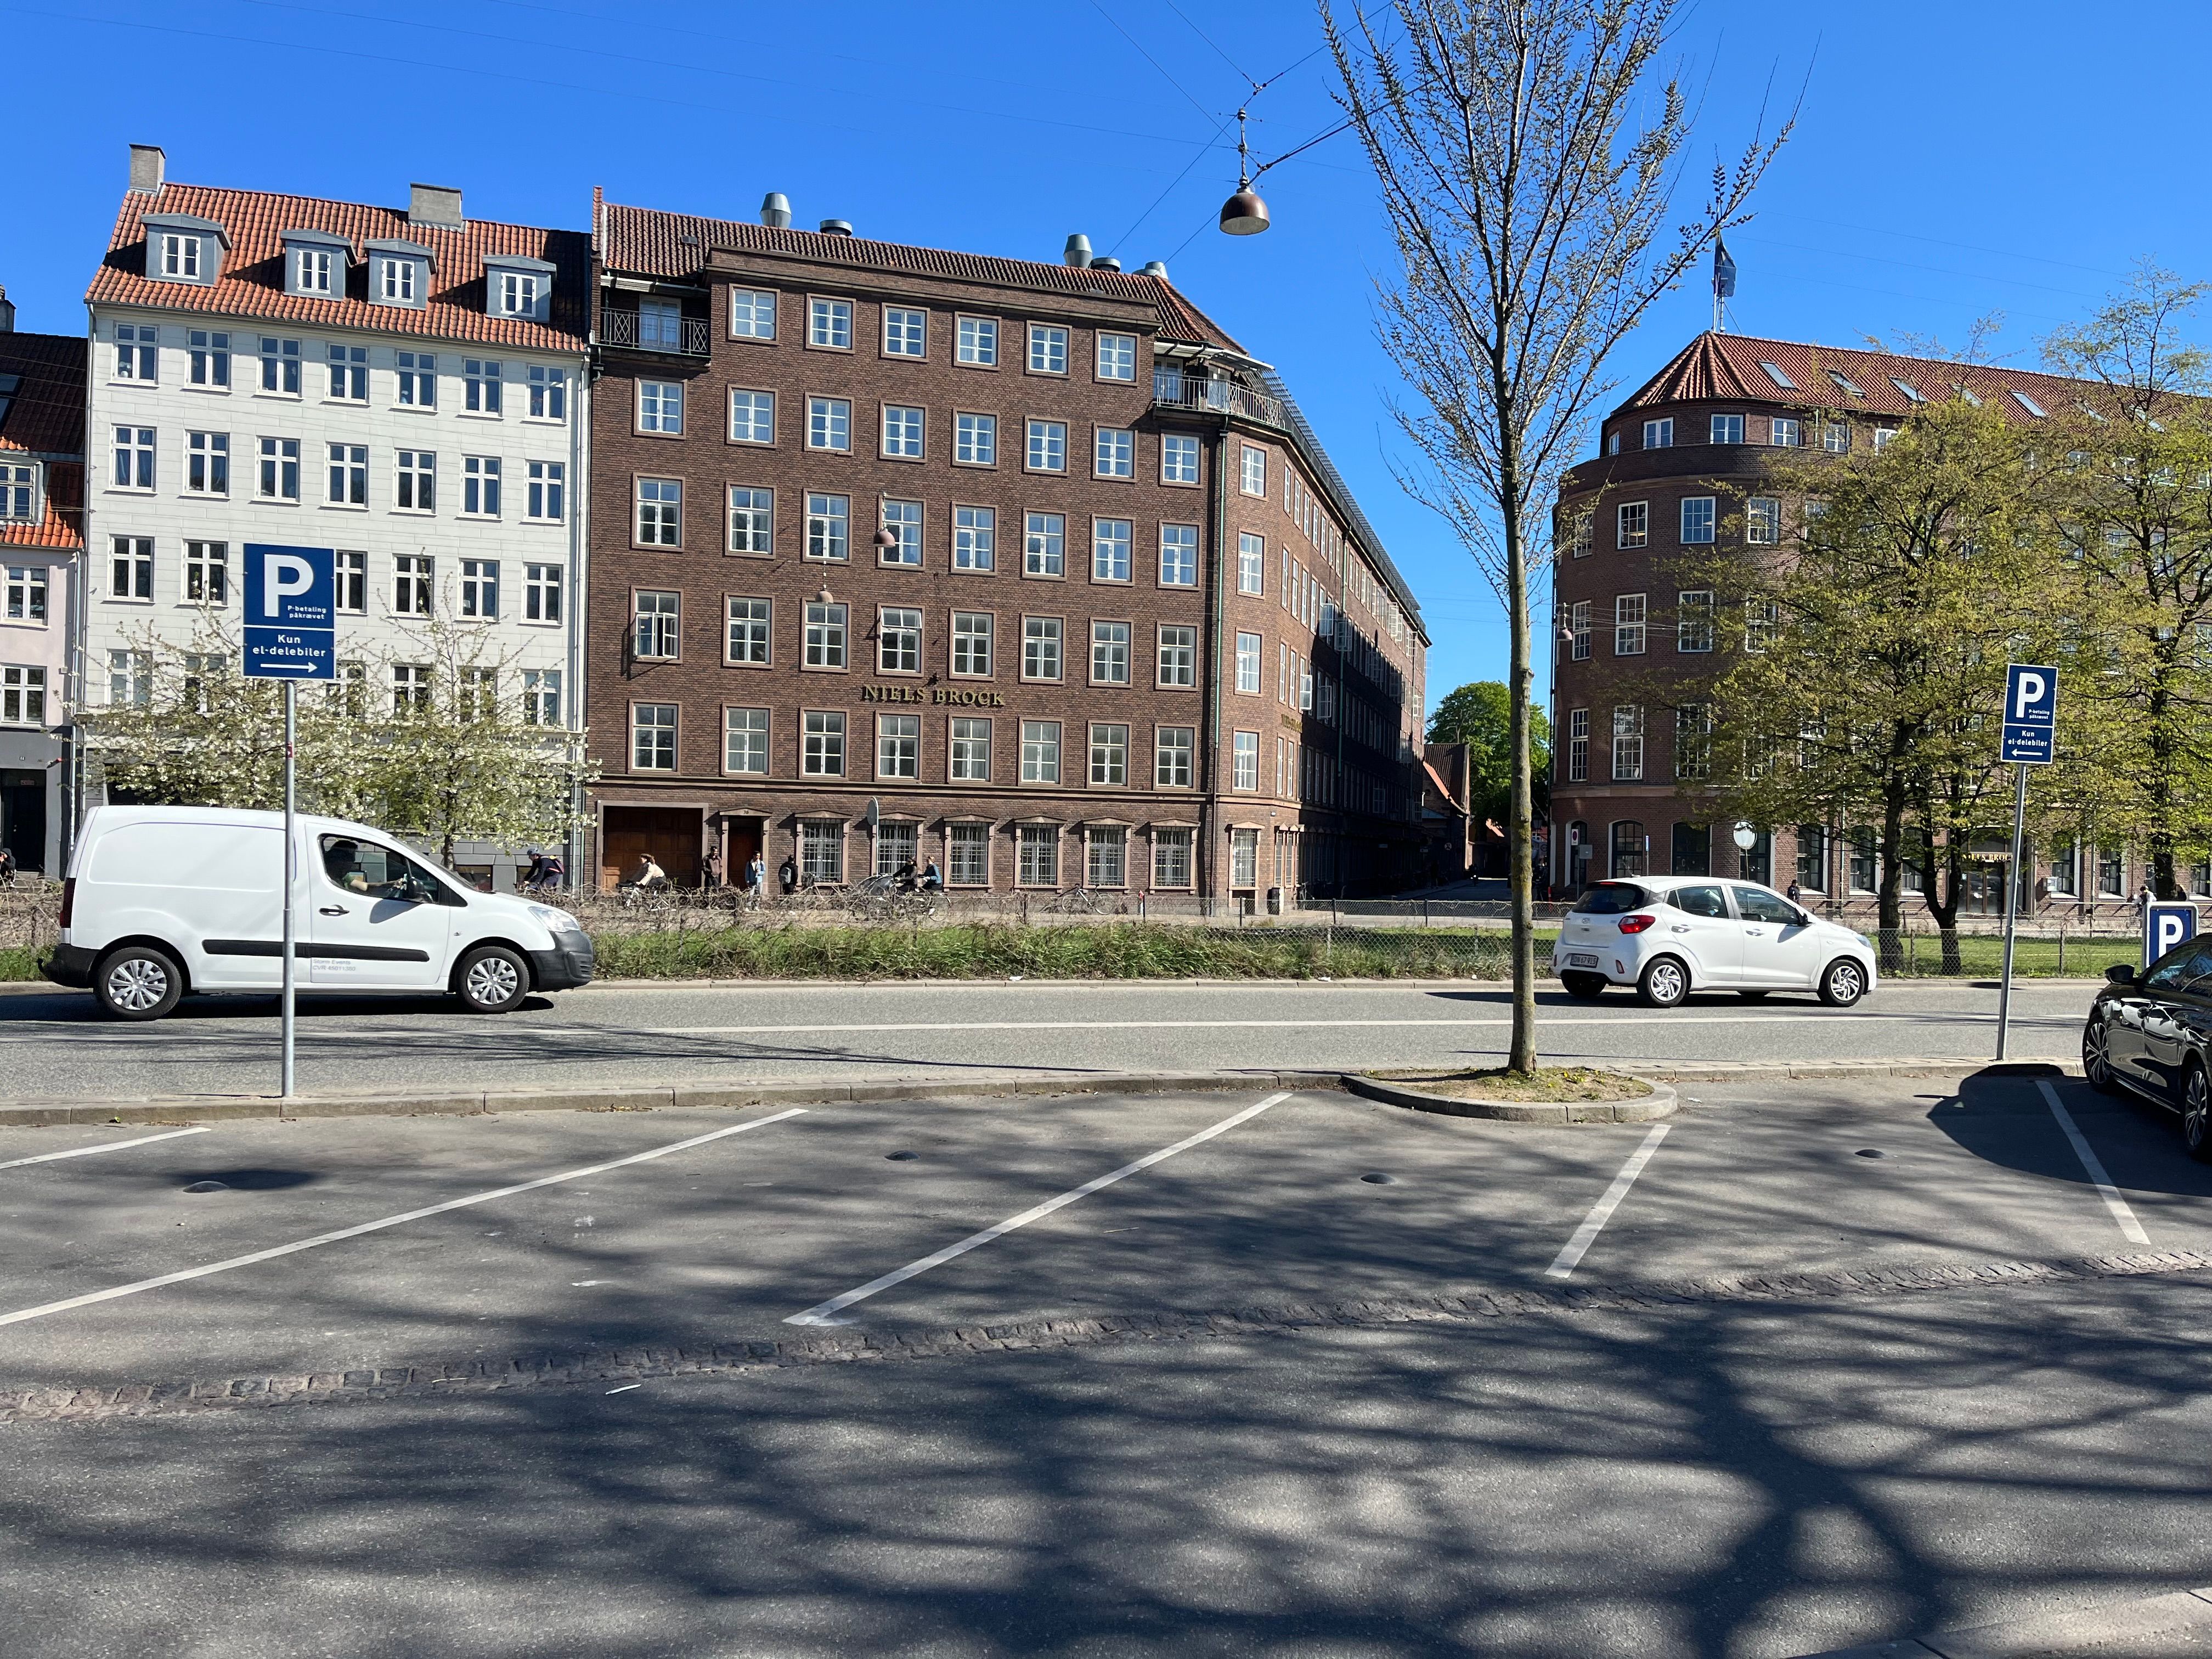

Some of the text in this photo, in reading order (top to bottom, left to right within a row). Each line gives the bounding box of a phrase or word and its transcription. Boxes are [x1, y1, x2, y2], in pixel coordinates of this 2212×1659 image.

[264, 554, 314, 617] P
[287, 605, 327, 614] P-betaling
[278, 634, 301, 644] Kun
[252, 646, 326, 657] el-delebiler
[864, 685, 1005, 706] NIELS BROCK
[2016, 672, 2045, 718] P
[2007, 738, 2049, 747] el-delebiler
[2158, 915, 2183, 958] P
